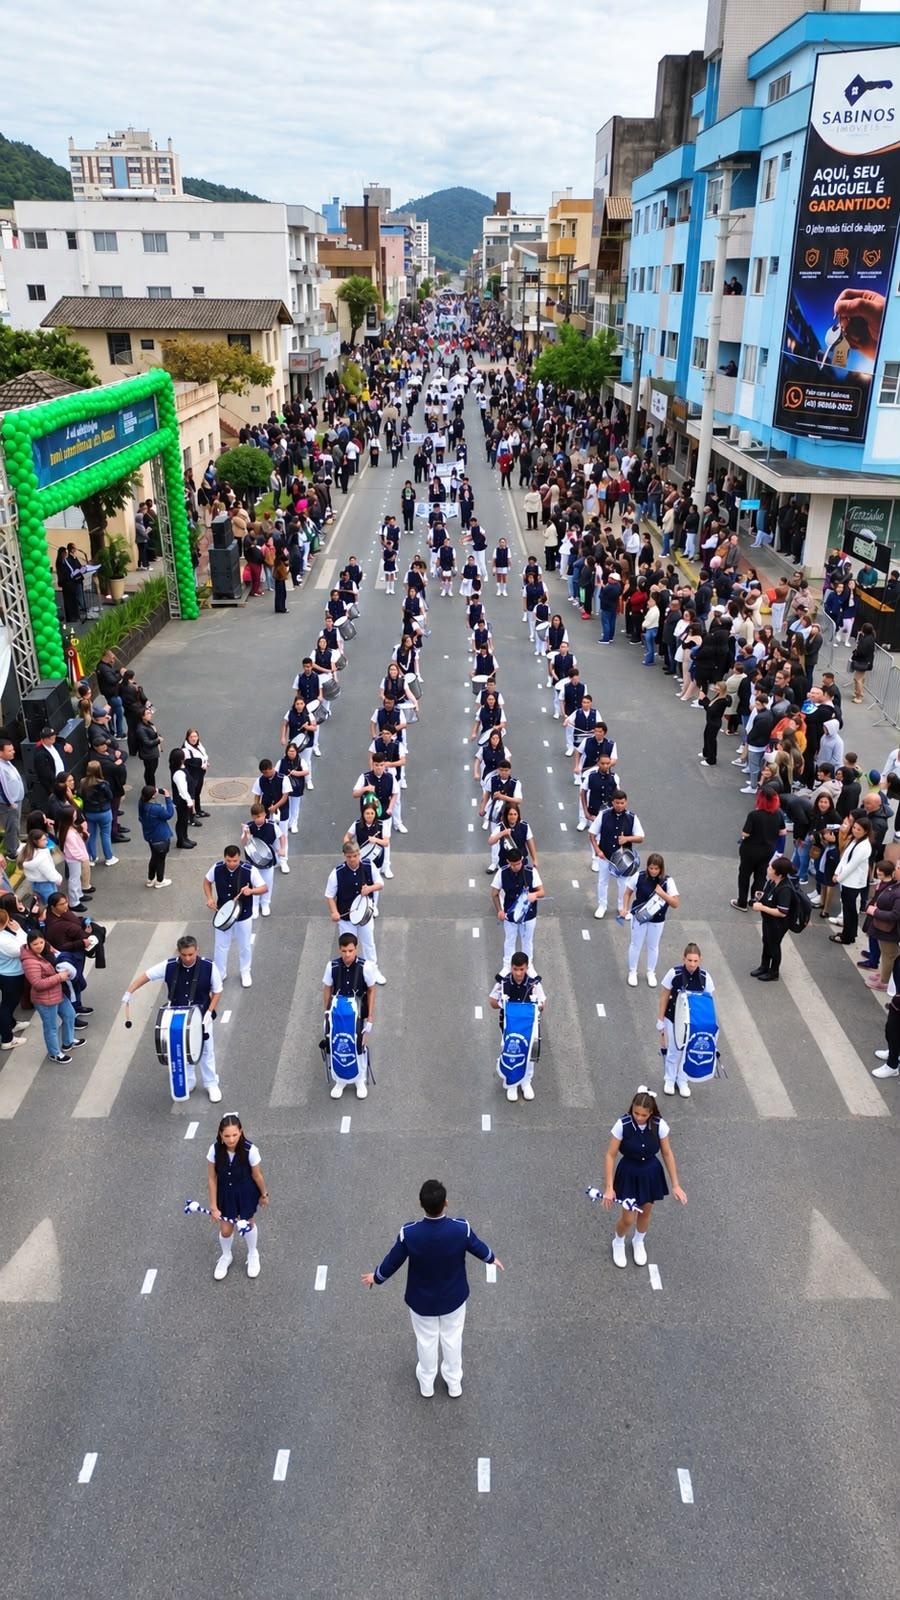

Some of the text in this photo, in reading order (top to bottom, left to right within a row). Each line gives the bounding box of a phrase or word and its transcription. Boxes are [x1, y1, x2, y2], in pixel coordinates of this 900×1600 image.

[822, 107, 895, 125] SABINOS
[853, 165, 880, 179] SEU
[810, 177, 885, 197] ALUGUEL É
[808, 197, 892, 212] GARANTIDO!
